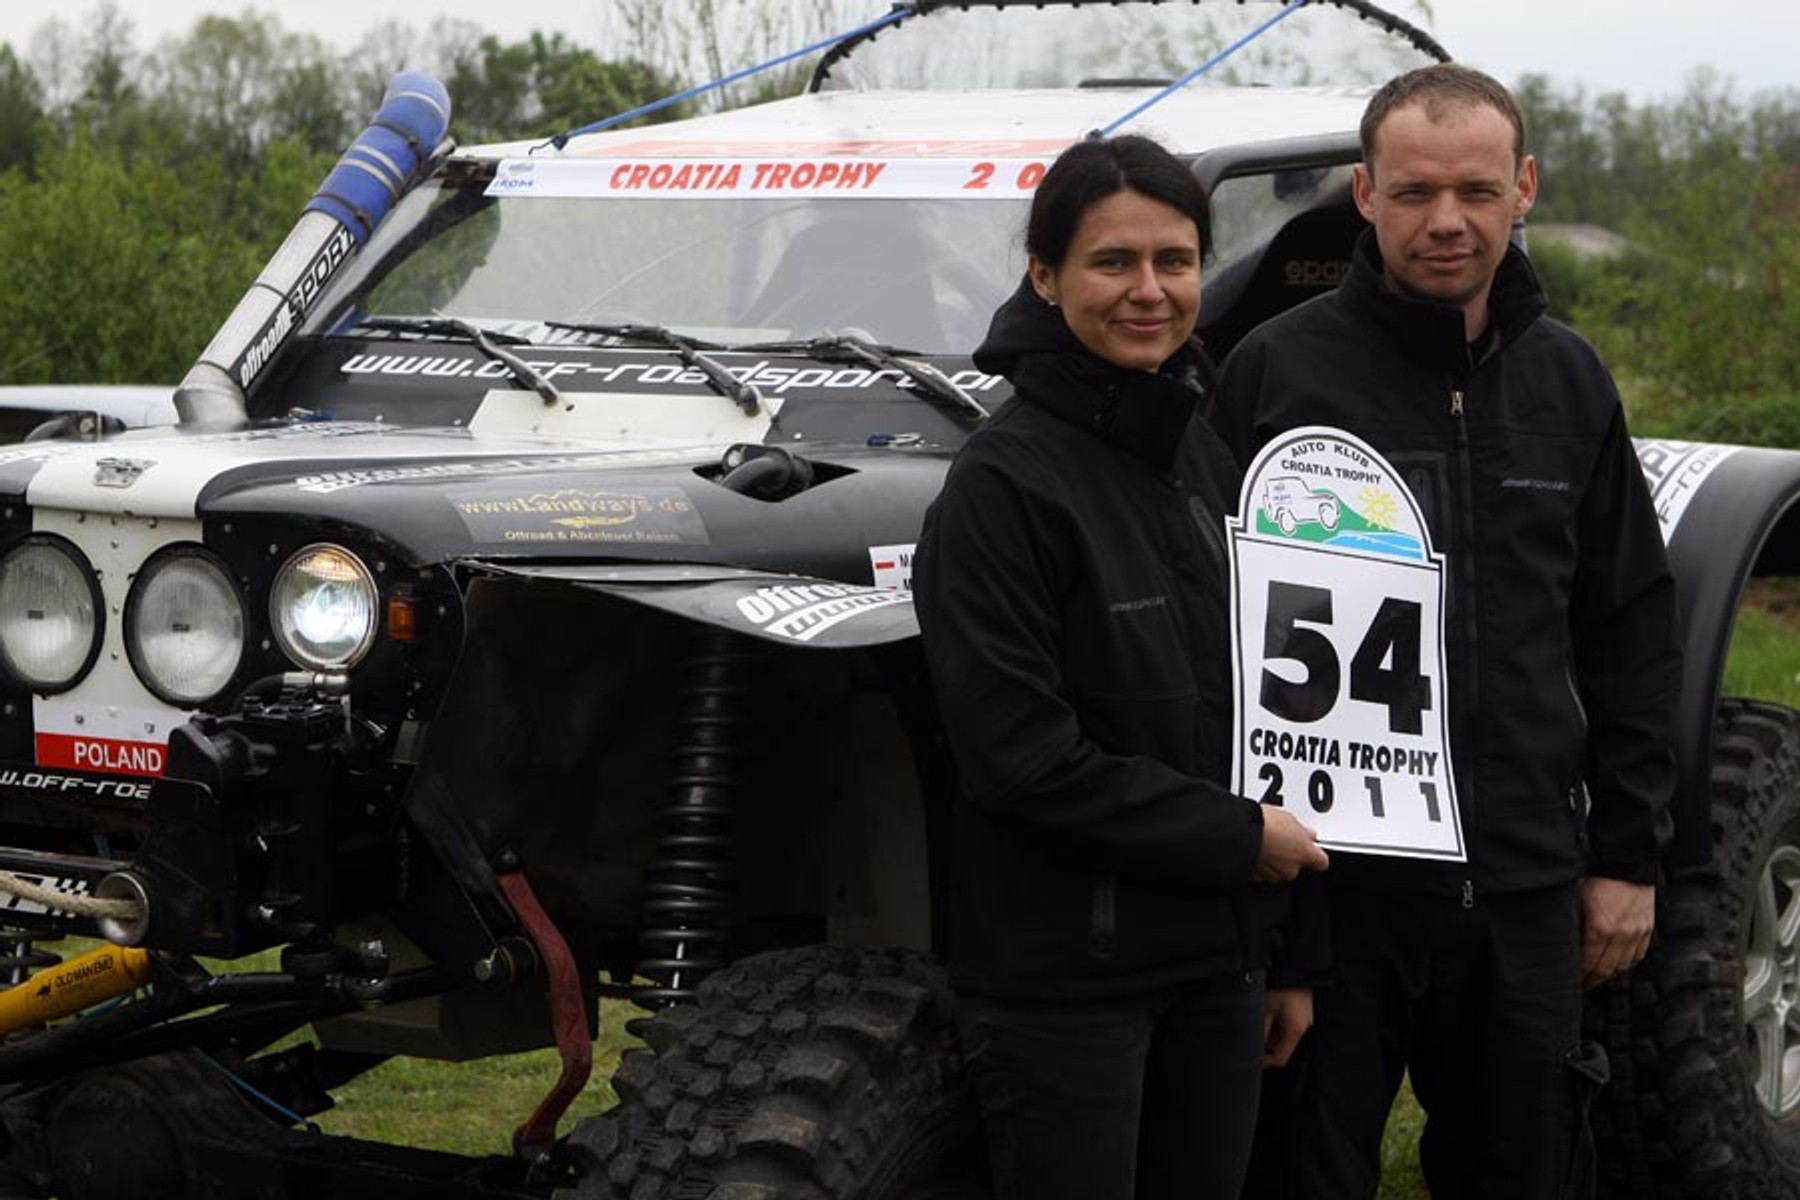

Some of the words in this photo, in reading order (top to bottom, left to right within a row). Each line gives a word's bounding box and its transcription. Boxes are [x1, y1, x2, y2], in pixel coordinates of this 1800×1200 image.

[609, 164, 742, 190] CROATIA
[750, 162, 886, 190] TROPHY
[1290, 442, 1325, 458] AUTO
[1334, 444, 1370, 468] KLUB
[1280, 459, 1332, 477] CROATIA
[1335, 468, 1381, 485] TROPHY
[1259, 579, 1433, 737] 54
[74, 741, 162, 772] POLAND
[1250, 728, 1341, 769] CROATIA
[1348, 742, 1439, 777] TROPHY
